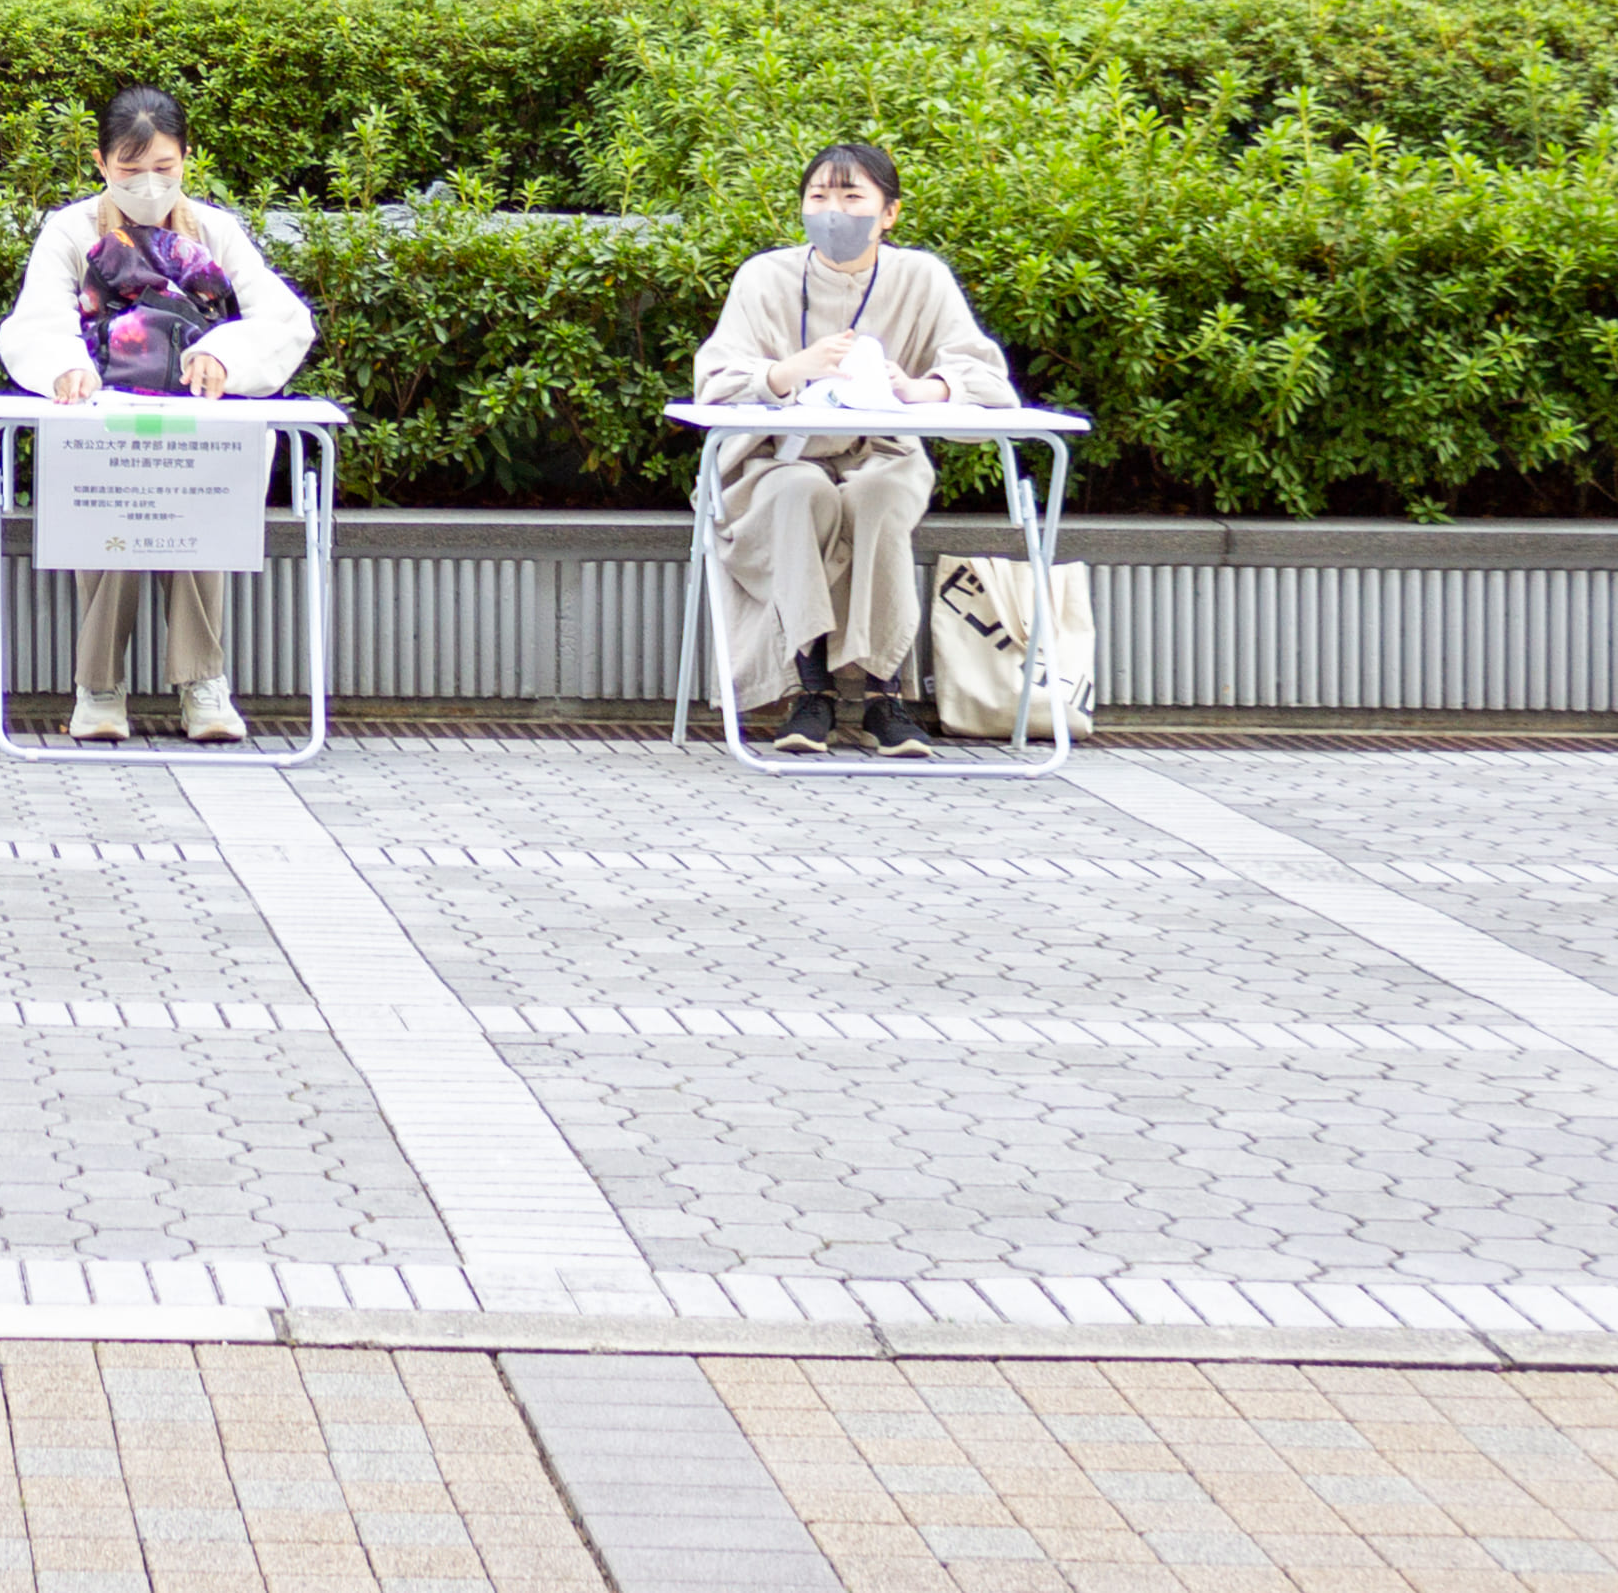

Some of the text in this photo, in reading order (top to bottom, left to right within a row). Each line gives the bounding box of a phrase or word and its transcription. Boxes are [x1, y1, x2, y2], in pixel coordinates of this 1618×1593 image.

[63, 440, 242, 452] 大阪公立大学 農学部 緑地環境科学科
[109, 458, 195, 469] 緑地計画学研究室
[132, 537, 198, 549] 大阪公立大学
